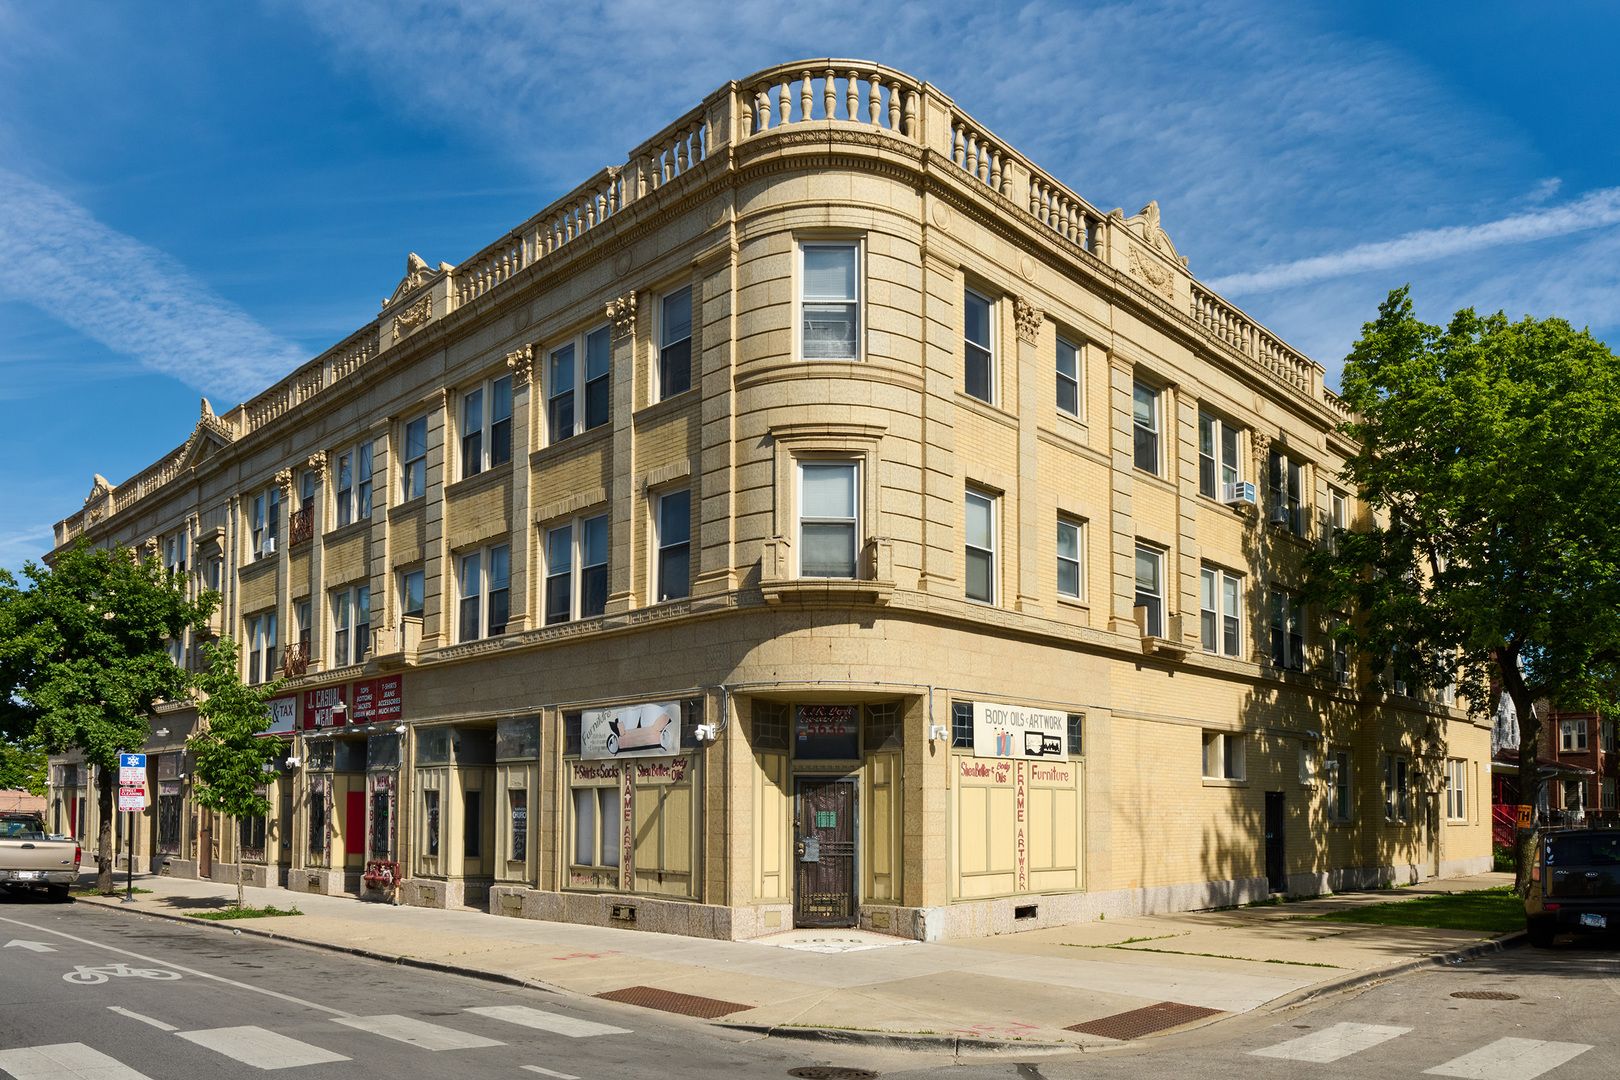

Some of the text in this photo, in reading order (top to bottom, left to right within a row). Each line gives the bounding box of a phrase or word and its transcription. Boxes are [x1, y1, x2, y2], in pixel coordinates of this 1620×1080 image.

[382, 682, 397, 690] T-SHIRTS
[316, 688, 340, 708] CASUAL
[356, 694, 372, 702] BOTTOMS
[378, 698, 400, 706] ACCESSORIES
[272, 703, 280, 723] &
[280, 704, 294, 717] TAX
[314, 708, 334, 726] WEAR
[985, 708, 1008, 725] BODY
[1010, 712, 1024, 727] OILS
[1028, 713, 1062, 730] ARTWORK
[573, 764, 596, 780] T-Shirts
[600, 763, 619, 778] Socks
[672, 757, 688, 770] Body
[996, 762, 1011, 772] Body
[995, 771, 1007, 783] Oils
[1032, 764, 1069, 782] Furniture
[624, 762, 632, 890] FRAME ARTWORK
